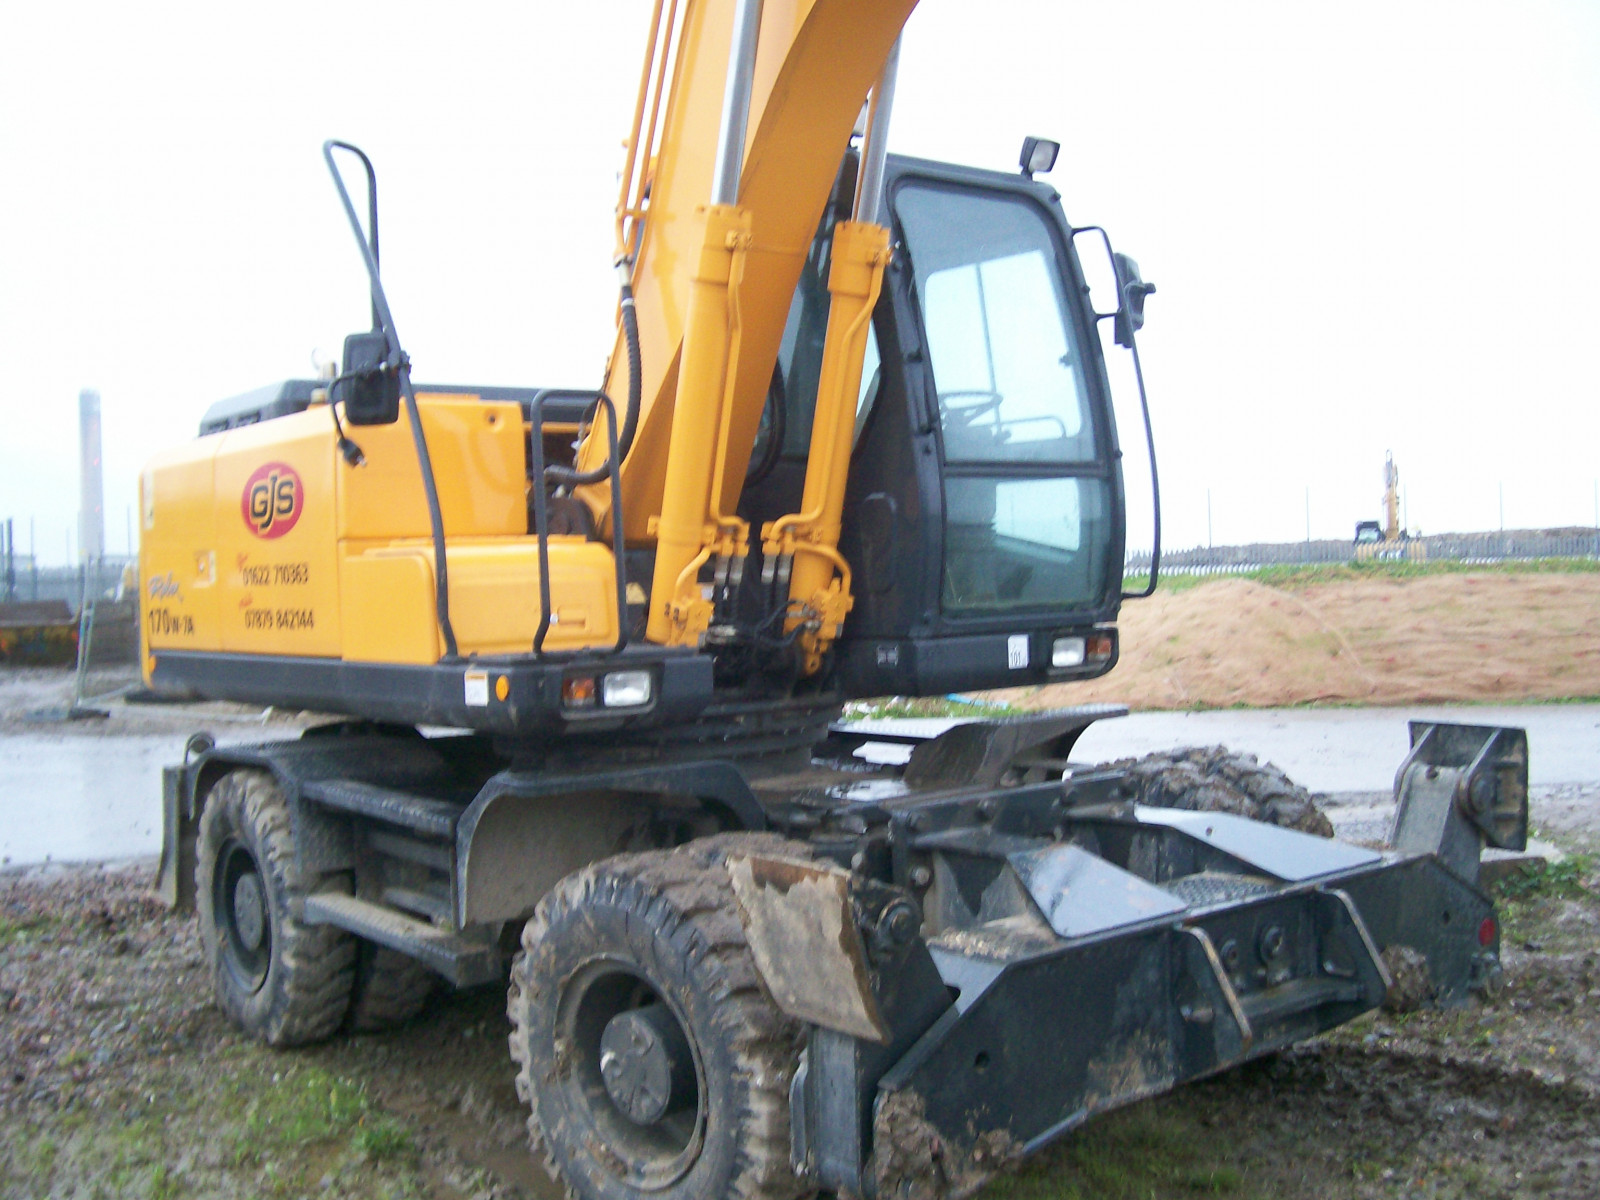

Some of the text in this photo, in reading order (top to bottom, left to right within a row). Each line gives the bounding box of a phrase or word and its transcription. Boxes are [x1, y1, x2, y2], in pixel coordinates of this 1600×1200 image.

[251, 474, 294, 530] GJS
[242, 565, 270, 586] 01622
[245, 608, 314, 630] 07879 842144
